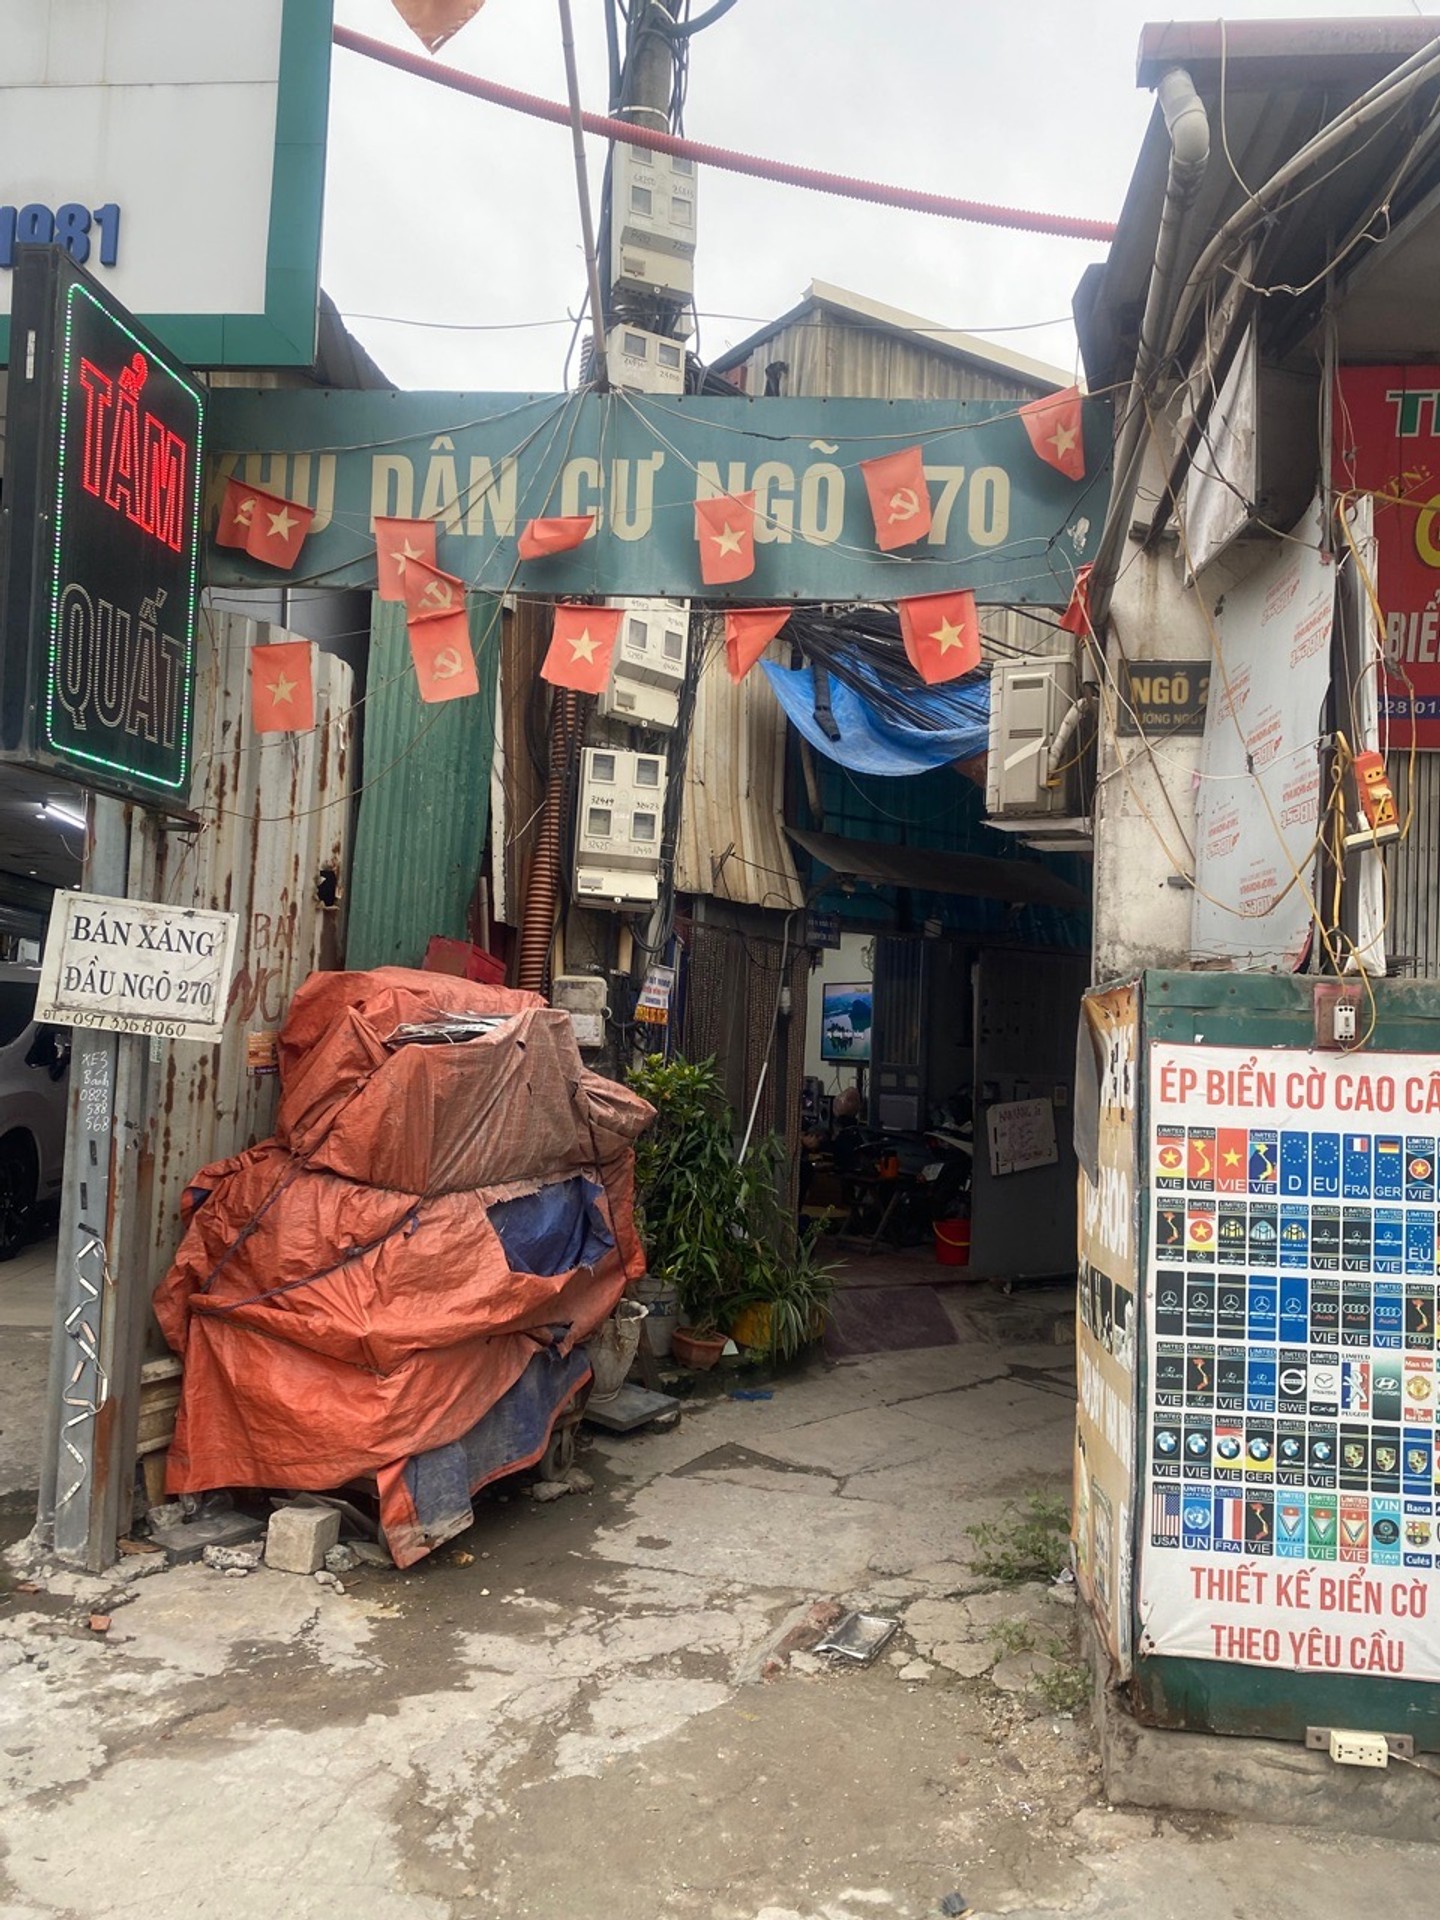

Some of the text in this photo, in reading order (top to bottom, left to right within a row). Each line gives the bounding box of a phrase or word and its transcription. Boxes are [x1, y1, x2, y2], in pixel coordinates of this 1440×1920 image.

[79, 352, 187, 554] TẨM
[370, 438, 518, 537] DÂN
[562, 447, 664, 542] CƯ
[697, 441, 845, 544] NGÕ
[922, 465, 1010, 546] 70
[1382, 588, 1440, 663] BIỂ
[55, 588, 186, 750] QUẤT
[1131, 671, 1189, 705] NGÕ
[71, 911, 216, 957] BÁN XĂNG
[63, 955, 212, 1006] ĐẦU NGÕ 270
[1160, 1061, 1197, 1104] ÉP
[1206, 1056, 1276, 1108] BIỂN
[1286, 1066, 1328, 1110] CỜ
[1335, 1074, 1396, 1113] CAO
[80, 1087, 108, 1102] 0823
[86, 1102, 108, 1116] 588
[85, 1115, 110, 1132] 568
[1160, 1178, 1181, 1189] VIE
[1190, 1181, 1212, 1191] VIE
[1218, 1179, 1246, 1192] VIE
[1252, 1183, 1274, 1194] VIE
[1288, 1175, 1302, 1191] D
[1313, 1177, 1338, 1192] EU
[1344, 1185, 1369, 1196] FRA
[1374, 1186, 1402, 1197] GER
[1408, 1189, 1432, 1200] VIE
[1408, 1248, 1431, 1261] EU
[1313, 1258, 1338, 1269] VIE
[1344, 1260, 1369, 1271] VIE
[1376, 1261, 1400, 1272] VIE
[1312, 1332, 1337, 1343] VIE
[1344, 1334, 1368, 1345] VIE
[1375, 1336, 1400, 1347] VIE
[1158, 1394, 1181, 1405] VIE
[1219, 1399, 1242, 1409] VIE
[1249, 1400, 1273, 1411] VIE
[1280, 1402, 1306, 1413] SWE
[1155, 1465, 1178, 1476] VIE
[1185, 1467, 1209, 1478] VIE
[1216, 1470, 1240, 1480] VIE
[1246, 1472, 1272, 1482] GER
[1279, 1474, 1303, 1484] VIE
[1310, 1476, 1334, 1487] VIE
[1374, 1500, 1399, 1511] VIN
[1154, 1537, 1178, 1546] USA
[1185, 1536, 1209, 1549] UN
[1216, 1541, 1240, 1551] FRA
[1248, 1544, 1270, 1554] VIE
[1279, 1546, 1303, 1556] VIE
[1310, 1548, 1335, 1559] VIE
[1342, 1550, 1366, 1562] VIE
[1406, 1555, 1430, 1566] Culés
[1190, 1561, 1428, 1619] THIẾT KẾ BIỂN CỜ
[1210, 1624, 1405, 1674] THEO YÊU CẦU
